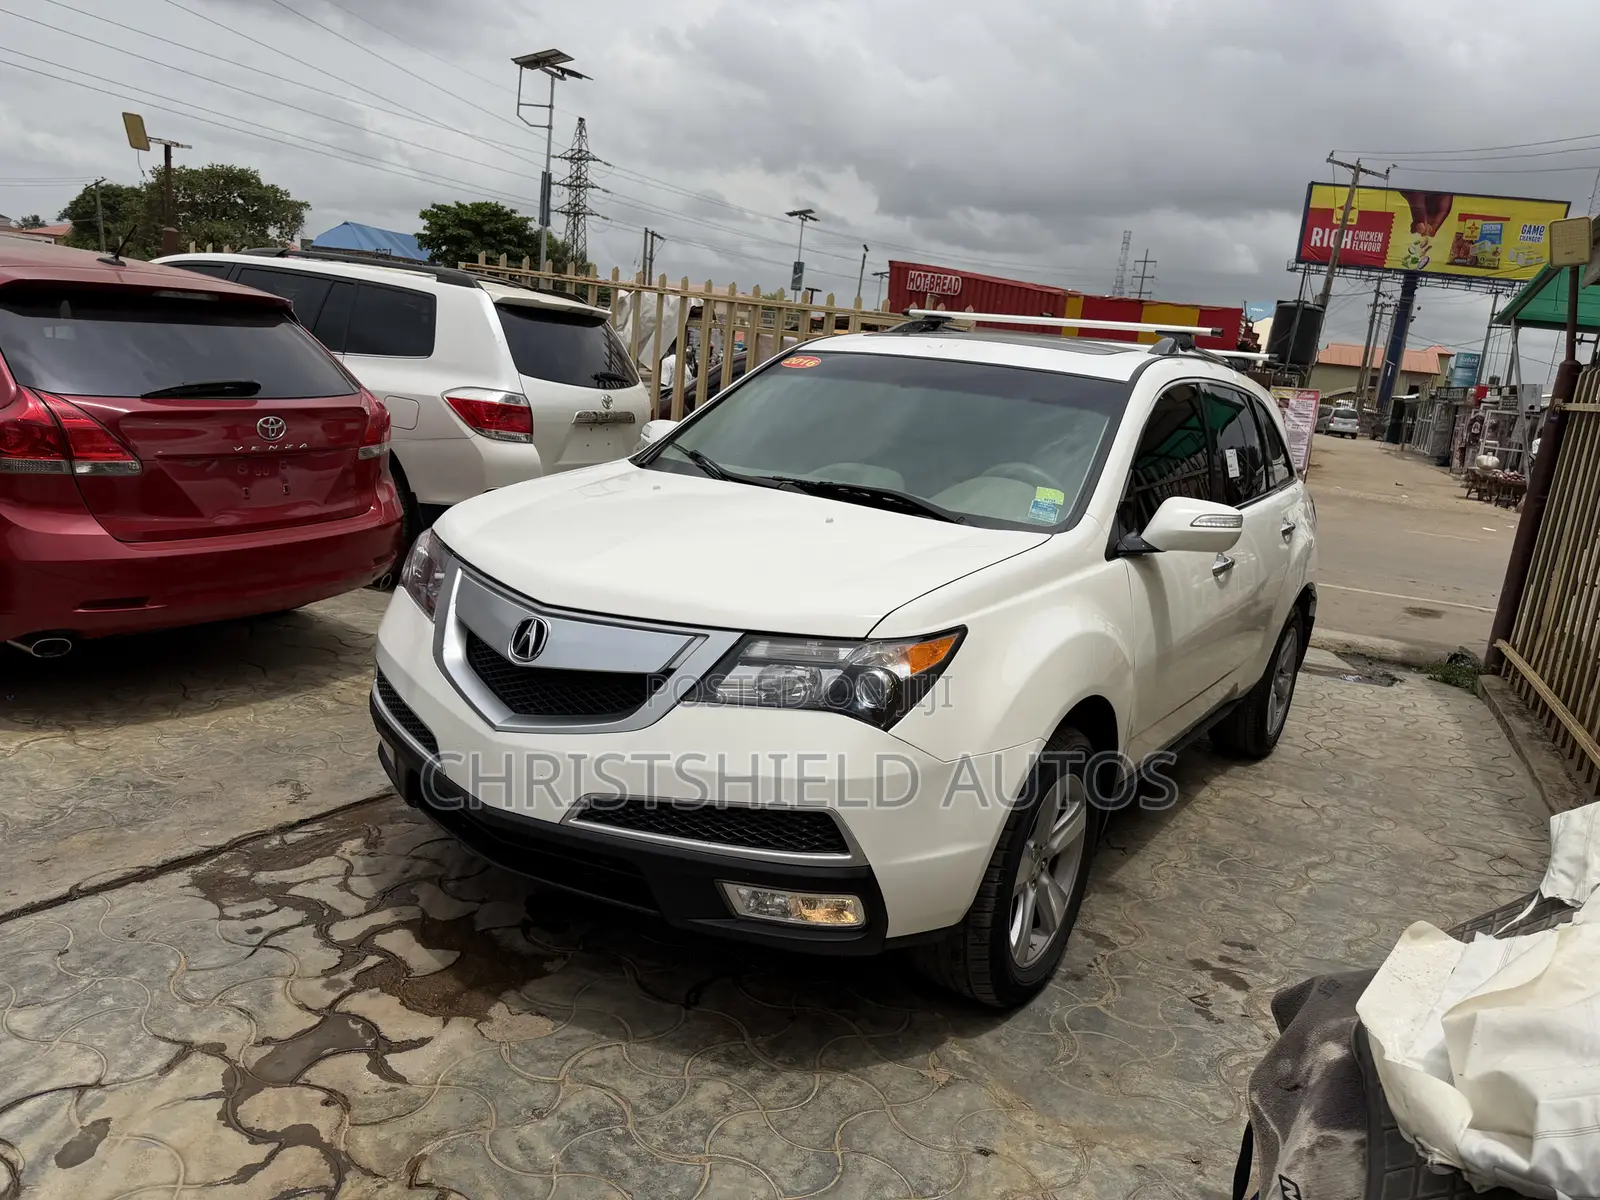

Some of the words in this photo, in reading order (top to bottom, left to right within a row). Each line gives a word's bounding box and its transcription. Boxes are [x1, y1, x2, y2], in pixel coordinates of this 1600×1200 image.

[1521, 224, 1545, 236] GAME
[1310, 227, 1353, 249] RICH
[1354, 230, 1384, 243] CHICKEN
[1352, 241, 1382, 253] FLAVOUR
[233, 442, 308, 452] VENZA
